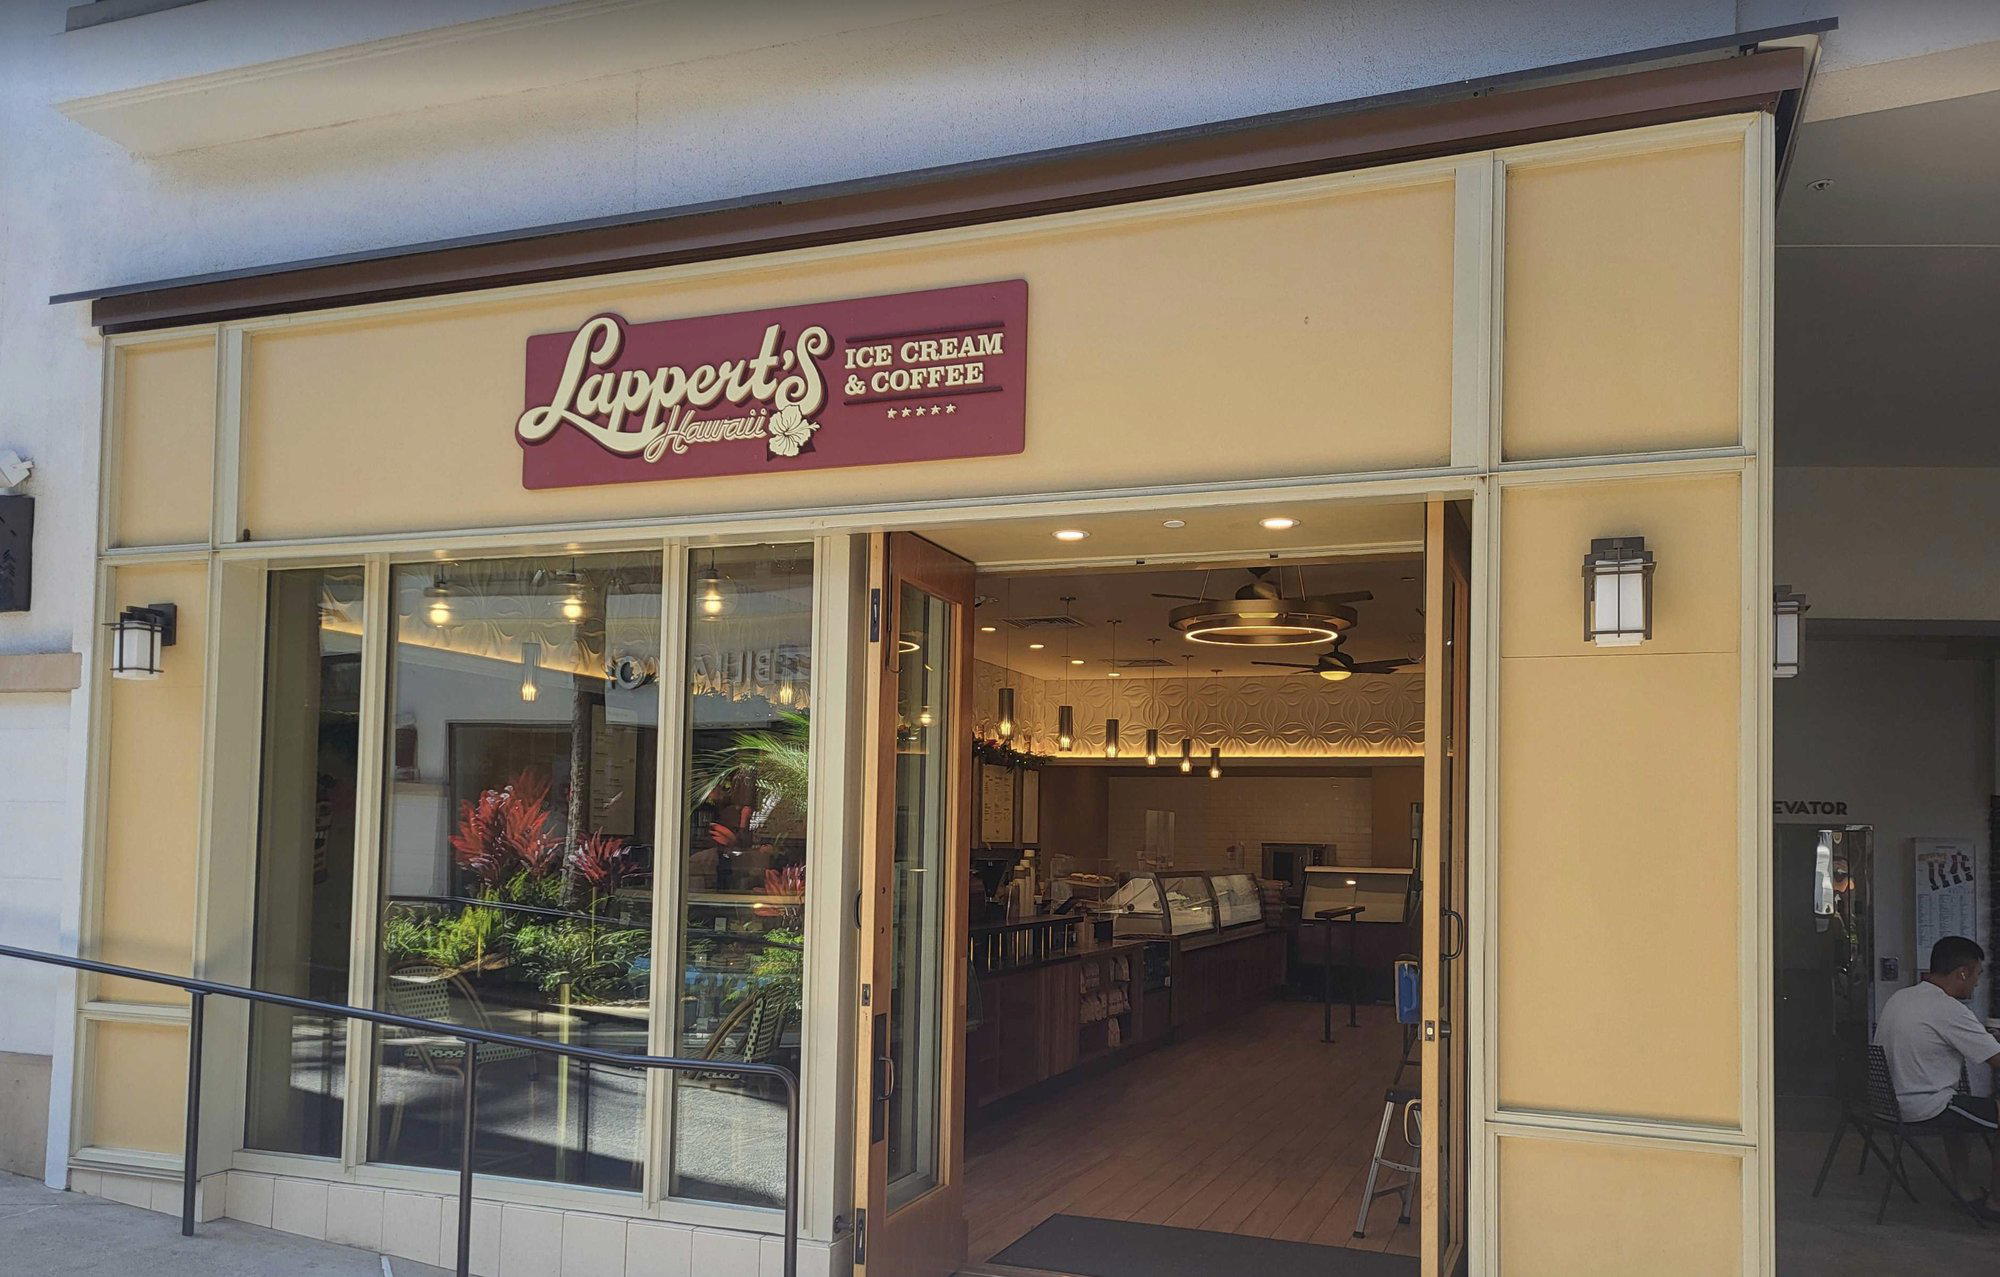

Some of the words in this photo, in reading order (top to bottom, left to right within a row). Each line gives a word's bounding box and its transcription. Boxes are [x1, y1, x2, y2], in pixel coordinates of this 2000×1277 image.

[844, 344, 893, 370] ICE
[900, 332, 1005, 364] CREAM
[844, 374, 867, 396] &
[871, 362, 984, 393] COFFEE
[643, 404, 767, 463] Hawaii
